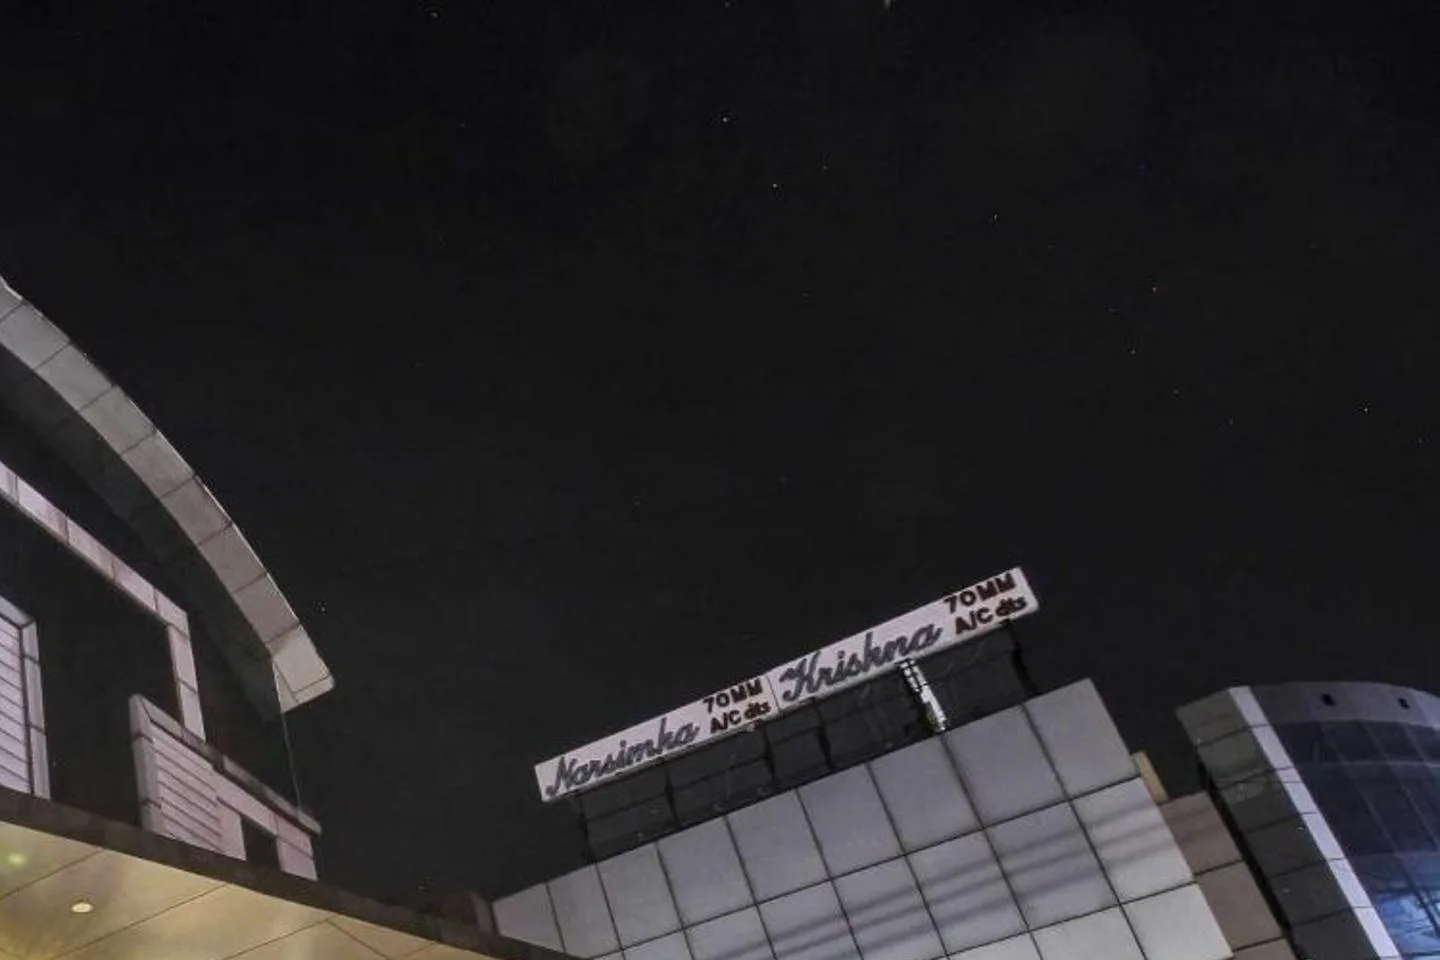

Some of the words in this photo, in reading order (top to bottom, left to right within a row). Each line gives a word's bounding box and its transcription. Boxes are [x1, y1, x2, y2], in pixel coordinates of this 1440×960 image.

[943, 573, 1016, 613] 70MM
[955, 607, 993, 634] A/C
[778, 623, 943, 701] Krishna
[703, 679, 763, 713] 70MM
[710, 710, 742, 733] A/C
[545, 717, 700, 796] Narsimha
